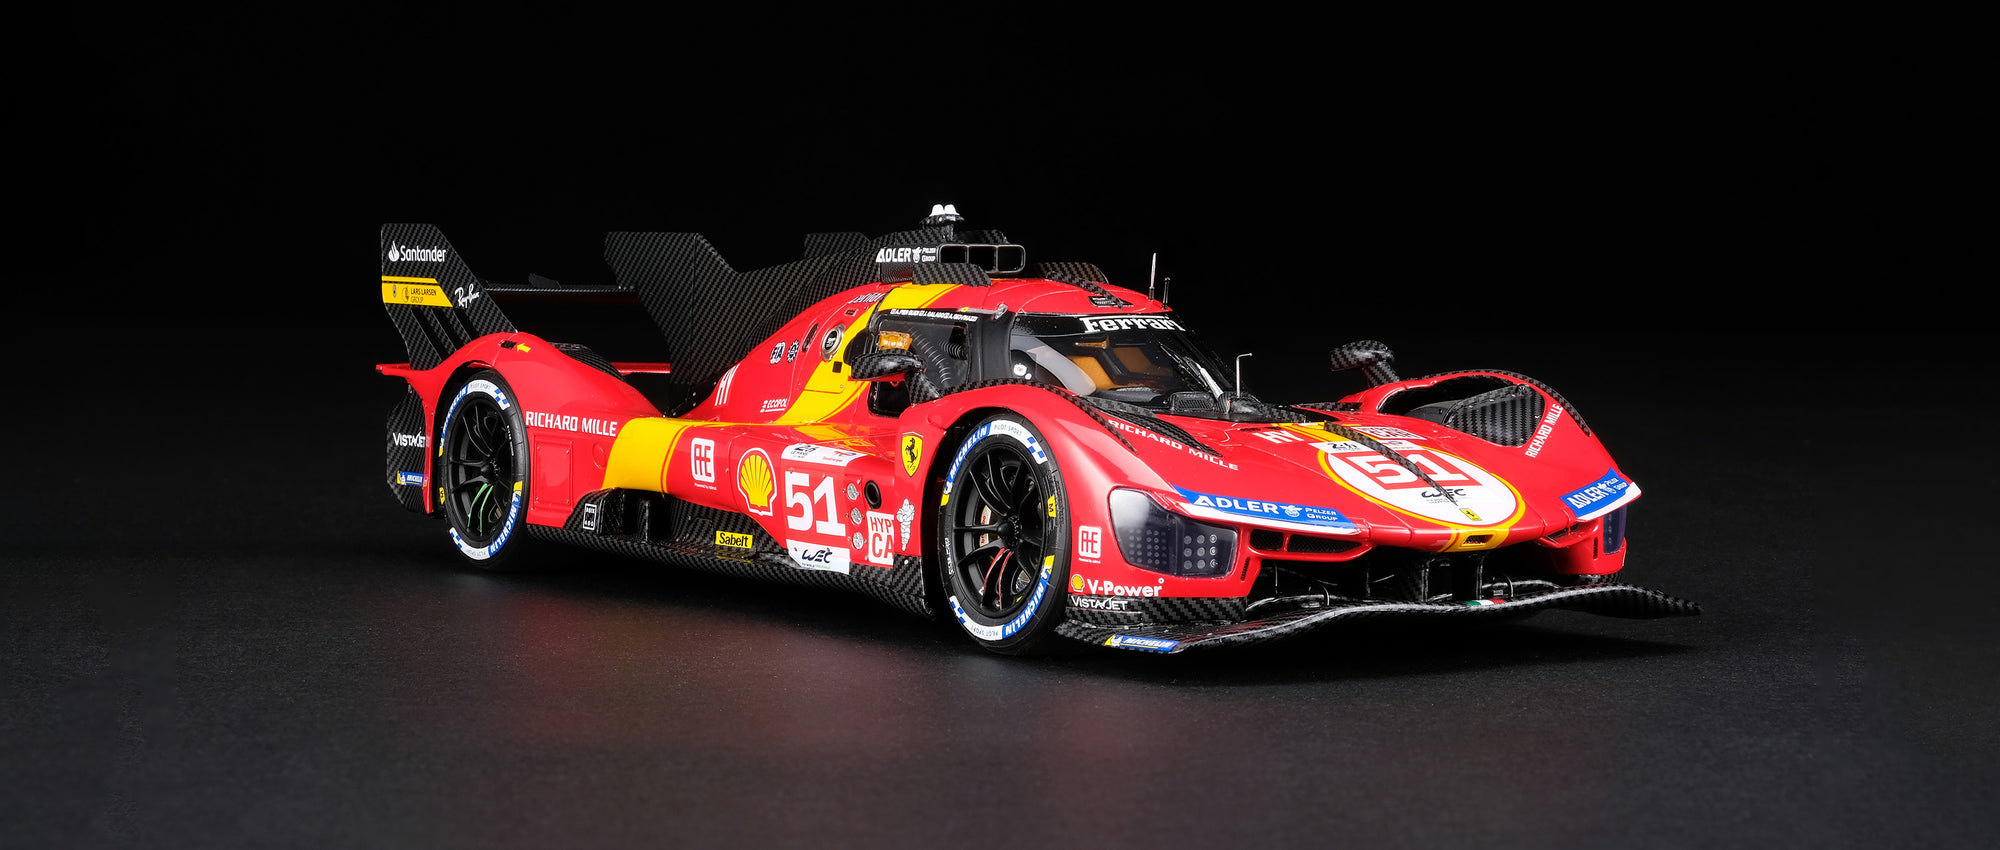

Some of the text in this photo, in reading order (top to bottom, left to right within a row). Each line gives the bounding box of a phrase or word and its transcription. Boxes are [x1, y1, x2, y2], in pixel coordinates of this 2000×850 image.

[400, 245, 446, 262] Santander
[876, 247, 912, 262] ADLER
[1079, 315, 1186, 334] Ferrari
[526, 411, 618, 437] RICHARD MILLE
[1525, 403, 1564, 458] RICHARD MILLE
[1108, 419, 1183, 450] RICHARD
[949, 426, 988, 479] MICHELIN
[1346, 454, 1470, 484] 51
[1421, 488, 1467, 498] WEC
[1567, 486, 1610, 509] ADLER
[785, 471, 846, 536] 51
[1193, 495, 1280, 514] ADLER
[1305, 507, 1337, 516] PELZER
[1306, 513, 1338, 521] GROUP
[489, 504, 517, 553] MICHELIN
[719, 532, 749, 547] Sabelt
[802, 549, 833, 564] WEC
[1005, 581, 1045, 636] MICHELIN
[1071, 595, 1128, 610] VISTAJET
[1123, 638, 1174, 648] MICHELIN
